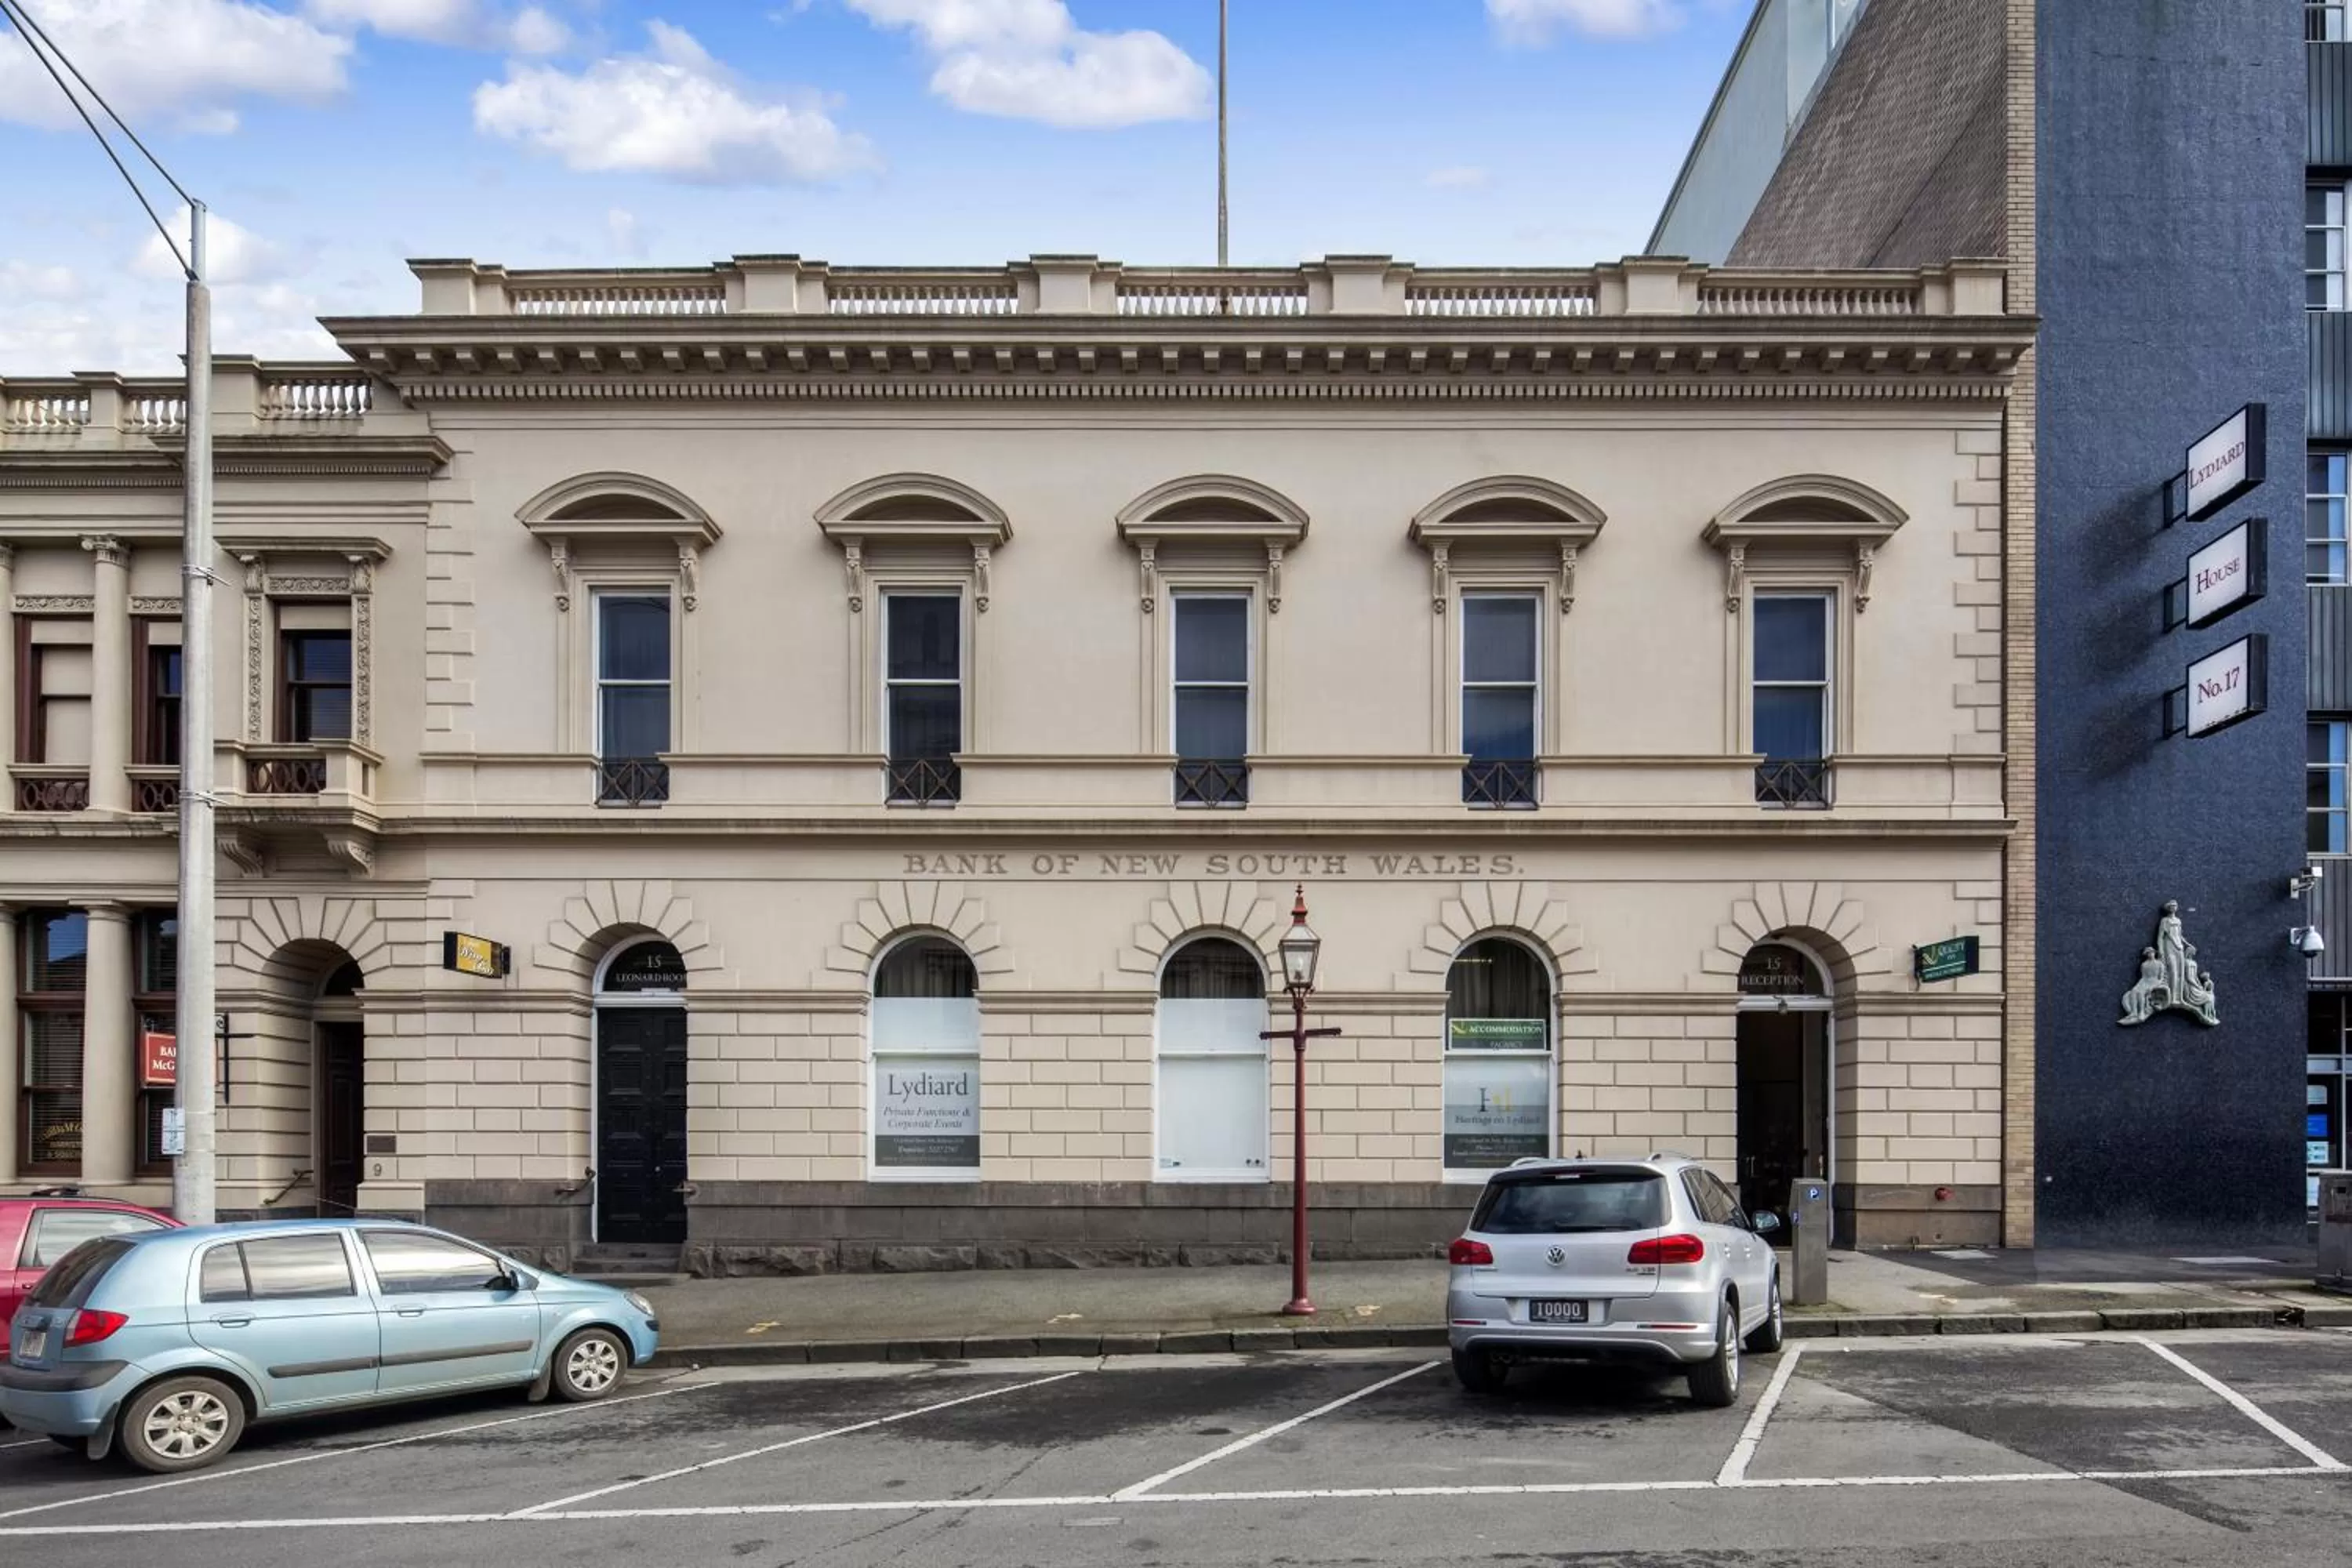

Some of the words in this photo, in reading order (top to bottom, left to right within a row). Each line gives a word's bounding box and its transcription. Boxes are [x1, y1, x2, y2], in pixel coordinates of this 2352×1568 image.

[903, 854, 1009, 875] BANK
[1031, 854, 1080, 875] OF
[1099, 854, 1181, 875] NEW
[1205, 854, 1348, 875] SOUTH
[1370, 854, 1524, 875] WALES.
[646, 955, 662, 968] 15
[1767, 956, 1781, 970] 15
[1741, 975, 1803, 985] RECEPTION
[1468, 1025, 1542, 1034] ACCOMMODATION
[887, 1072, 969, 1104] Lydiard
[372, 1163, 383, 1177] 9
